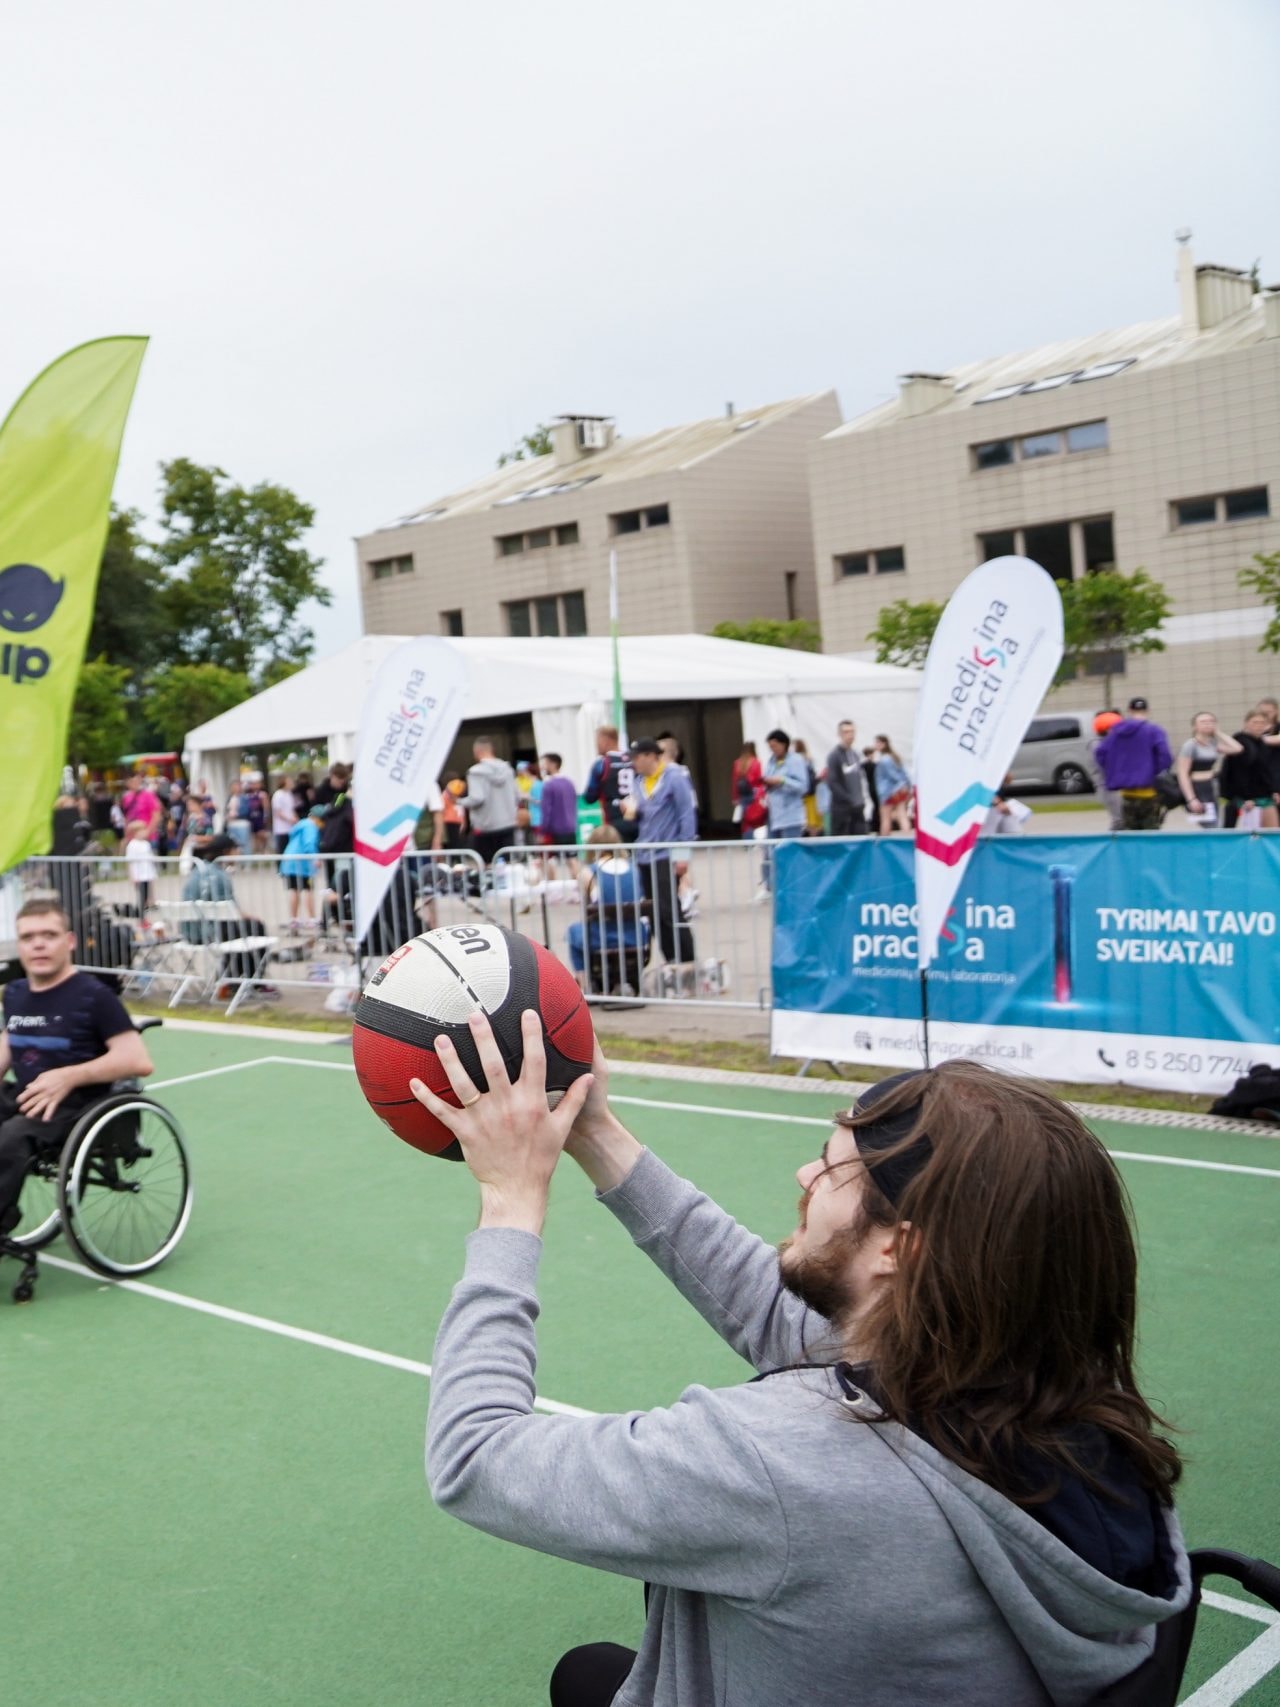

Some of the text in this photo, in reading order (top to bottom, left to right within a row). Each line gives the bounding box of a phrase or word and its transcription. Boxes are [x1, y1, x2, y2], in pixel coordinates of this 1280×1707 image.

[1096, 907, 1276, 936] TYRIMAI TAVO
[1096, 938, 1235, 966] SVEIKATAI!
[1126, 1049, 1139, 1068] 8
[1144, 1050, 1157, 1069] 5
[1162, 1052, 1202, 1073] 250
